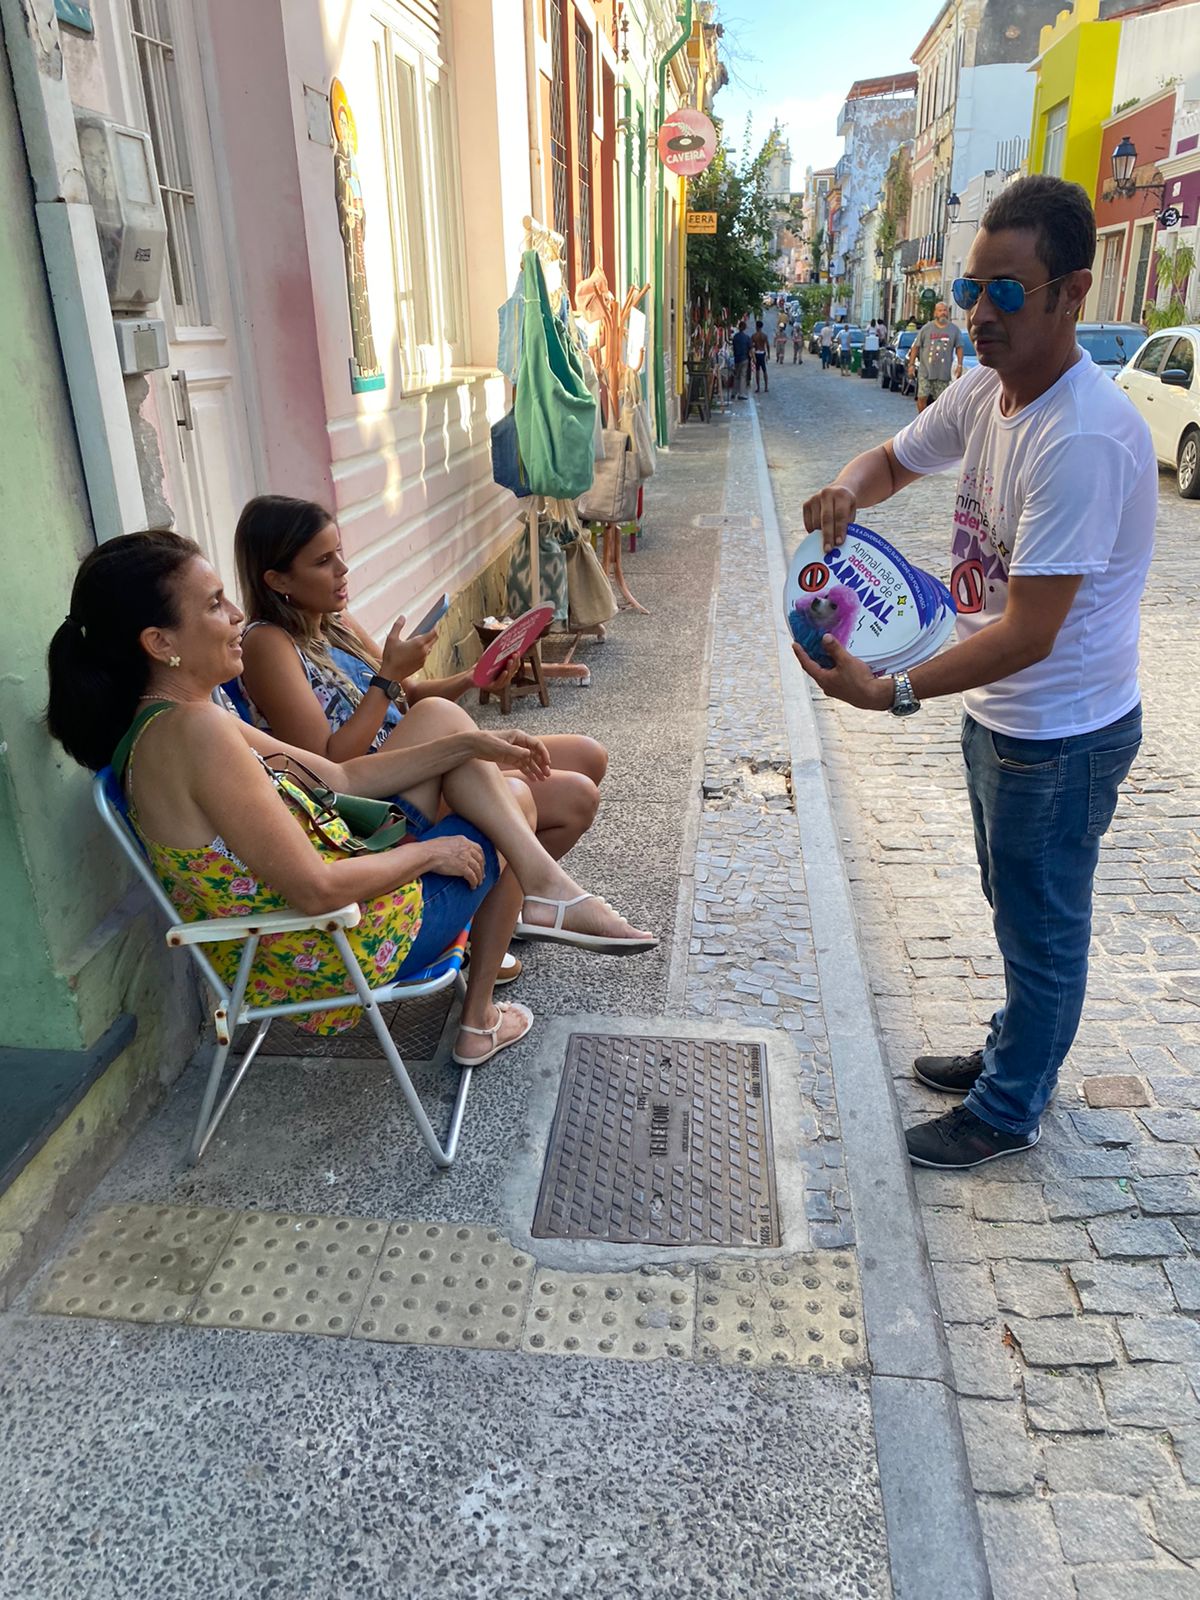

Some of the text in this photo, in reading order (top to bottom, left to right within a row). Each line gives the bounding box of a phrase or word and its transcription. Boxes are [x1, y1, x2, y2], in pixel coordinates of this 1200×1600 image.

[666, 149, 706, 164] CAVEIRA
[688, 214, 714, 224] FERA
[823, 548, 895, 625] CARNAVAL
[847, 554, 893, 598] adereço de
[851, 542, 904, 592] Animal não é
[649, 1102, 670, 1157] TELEFONE
